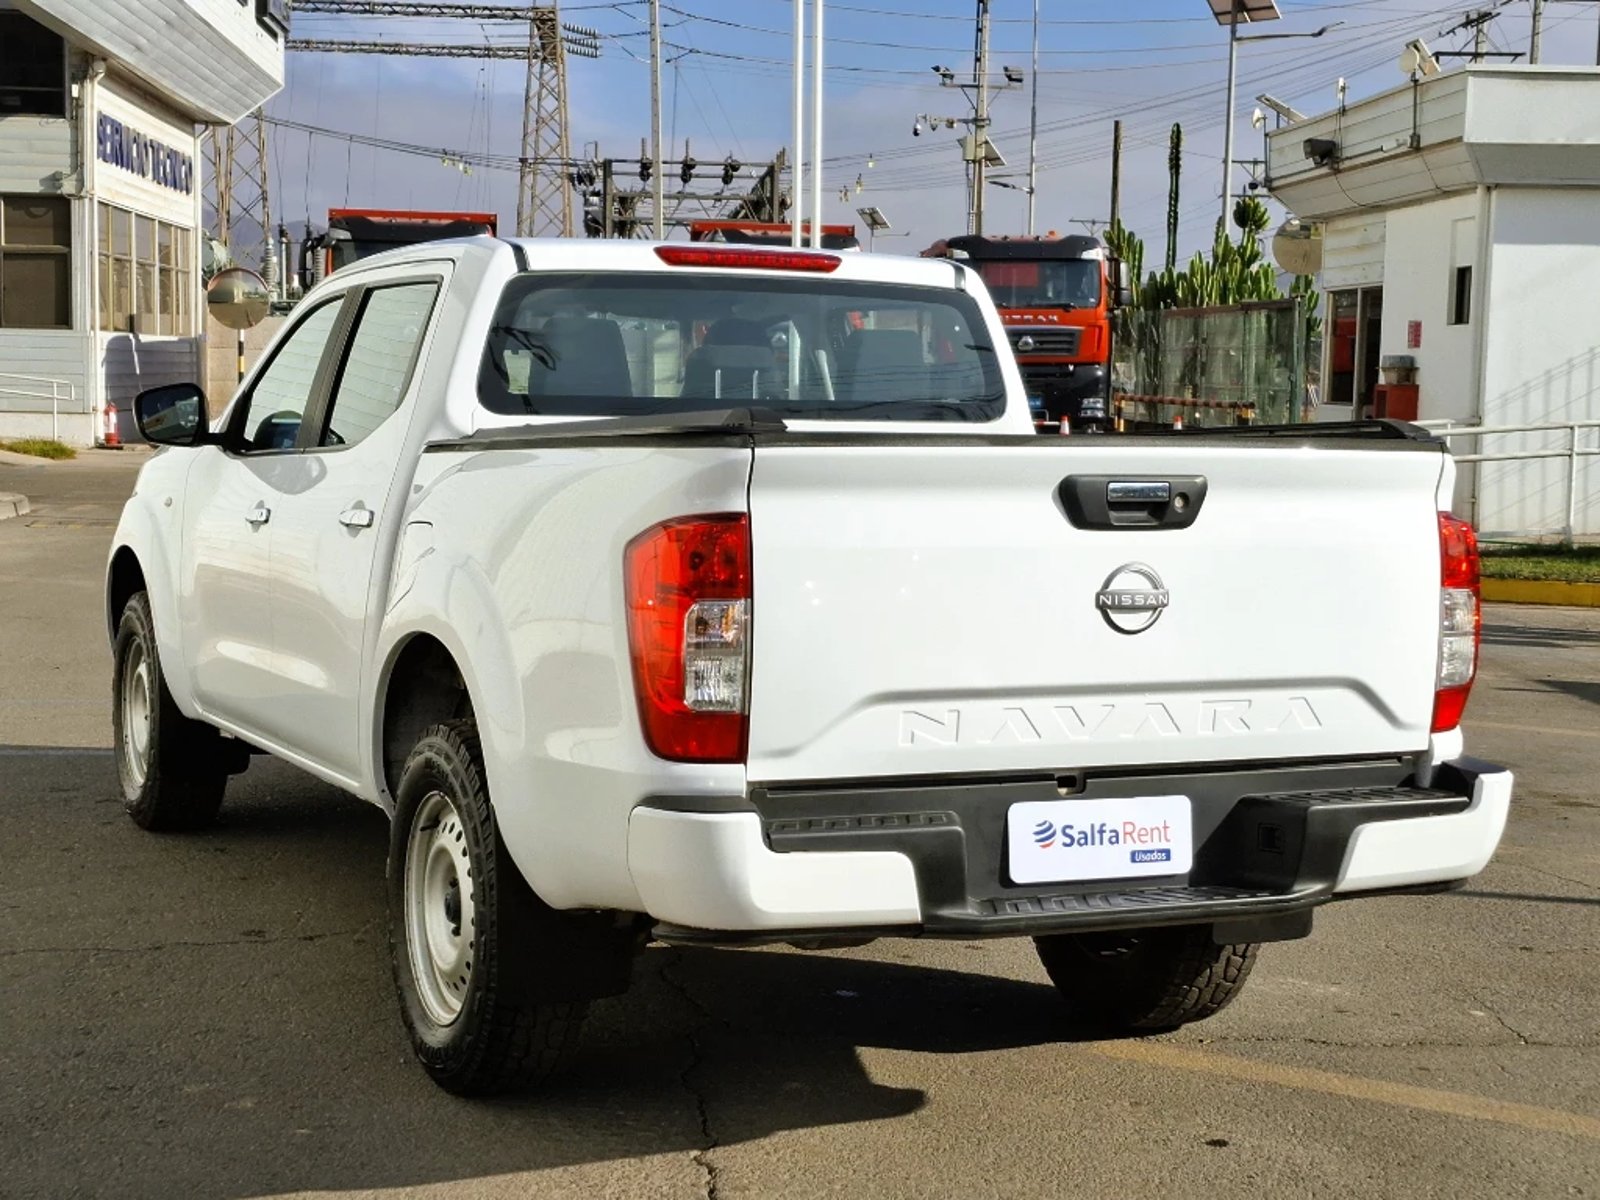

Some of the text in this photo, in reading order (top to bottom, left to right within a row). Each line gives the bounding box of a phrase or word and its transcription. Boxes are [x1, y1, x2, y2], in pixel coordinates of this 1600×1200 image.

[97, 111, 150, 178] SERVICIO
[1100, 594, 1168, 606] NISSAN
[899, 696, 1323, 747] NAVARA
[1135, 850, 1167, 862] Usados
